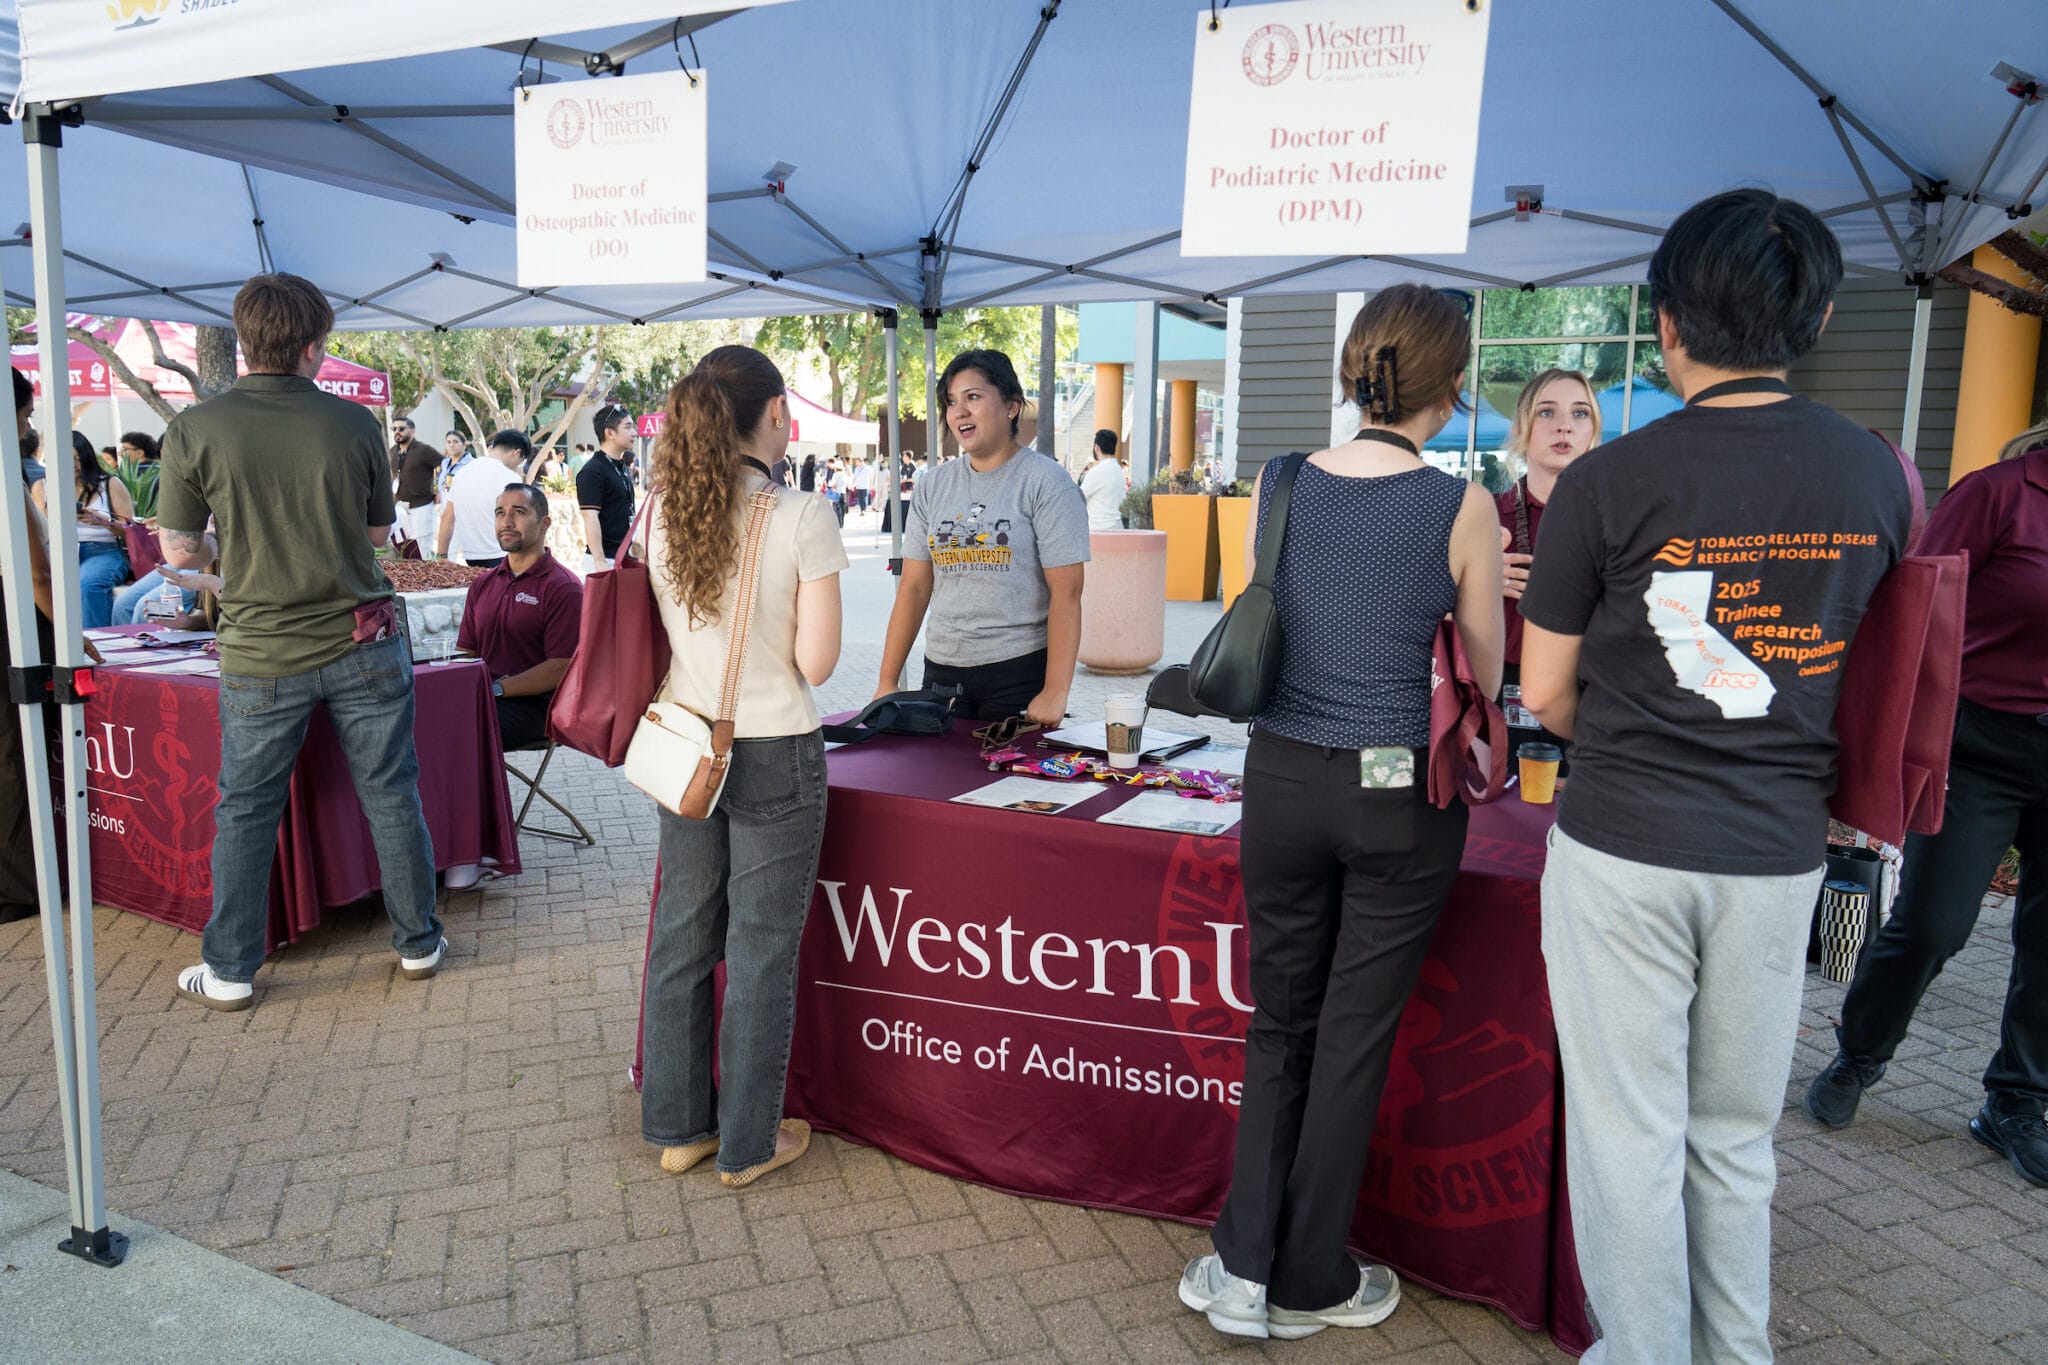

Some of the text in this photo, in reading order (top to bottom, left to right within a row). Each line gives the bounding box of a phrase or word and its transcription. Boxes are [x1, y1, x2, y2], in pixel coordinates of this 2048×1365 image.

[1304, 21, 1405, 51] Western
[1306, 43, 1432, 81] University
[587, 97, 654, 120] Western
[590, 115, 671, 144] University
[1269, 121, 1390, 150] Doctor of
[1210, 158, 1447, 188] Podiatric Medicine
[573, 179, 648, 200] Doctor of
[525, 207, 698, 234] Osteopathic Medicine
[1279, 199, 1363, 228] (DPM)
[589, 238, 629, 261] (DO)
[1832, 533, 1878, 546] DISEASE
[961, 550, 1013, 564] UNIVERSITY
[1768, 549, 1841, 560] PROGRAM
[969, 562, 1010, 572] SCIENCES
[1715, 579, 1761, 600] 2025
[1714, 604, 1782, 624] Trainee
[1734, 624, 1822, 640] Research
[1751, 639, 1846, 664] Symposium
[1701, 668, 1759, 689] free
[861, 1017, 1244, 1107] Office of Admissions
